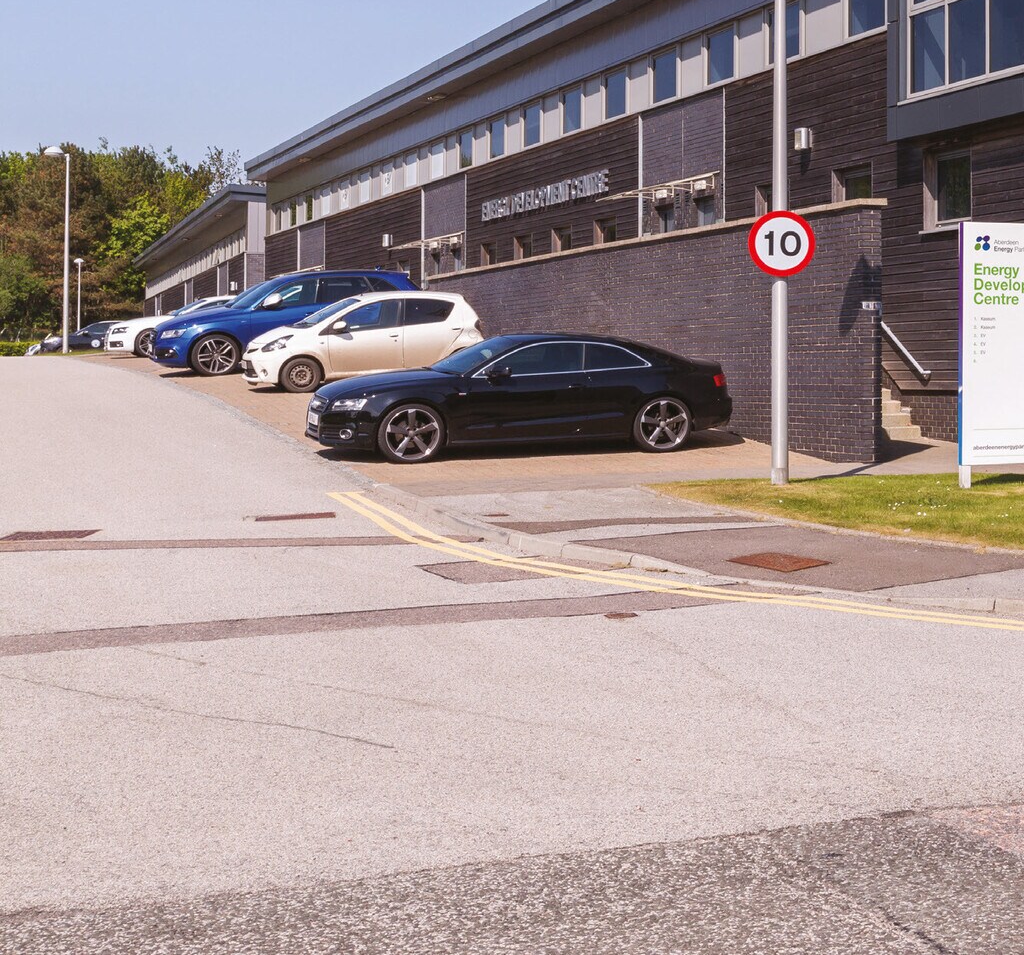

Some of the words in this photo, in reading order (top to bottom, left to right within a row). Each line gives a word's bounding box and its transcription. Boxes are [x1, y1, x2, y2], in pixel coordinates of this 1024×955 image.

[510, 179, 571, 214] DEVELOPMENT
[571, 168, 609, 200] CENTRE
[764, 230, 802, 257] 10
[974, 263, 1020, 278] Energy
[973, 292, 1019, 305] Centre
